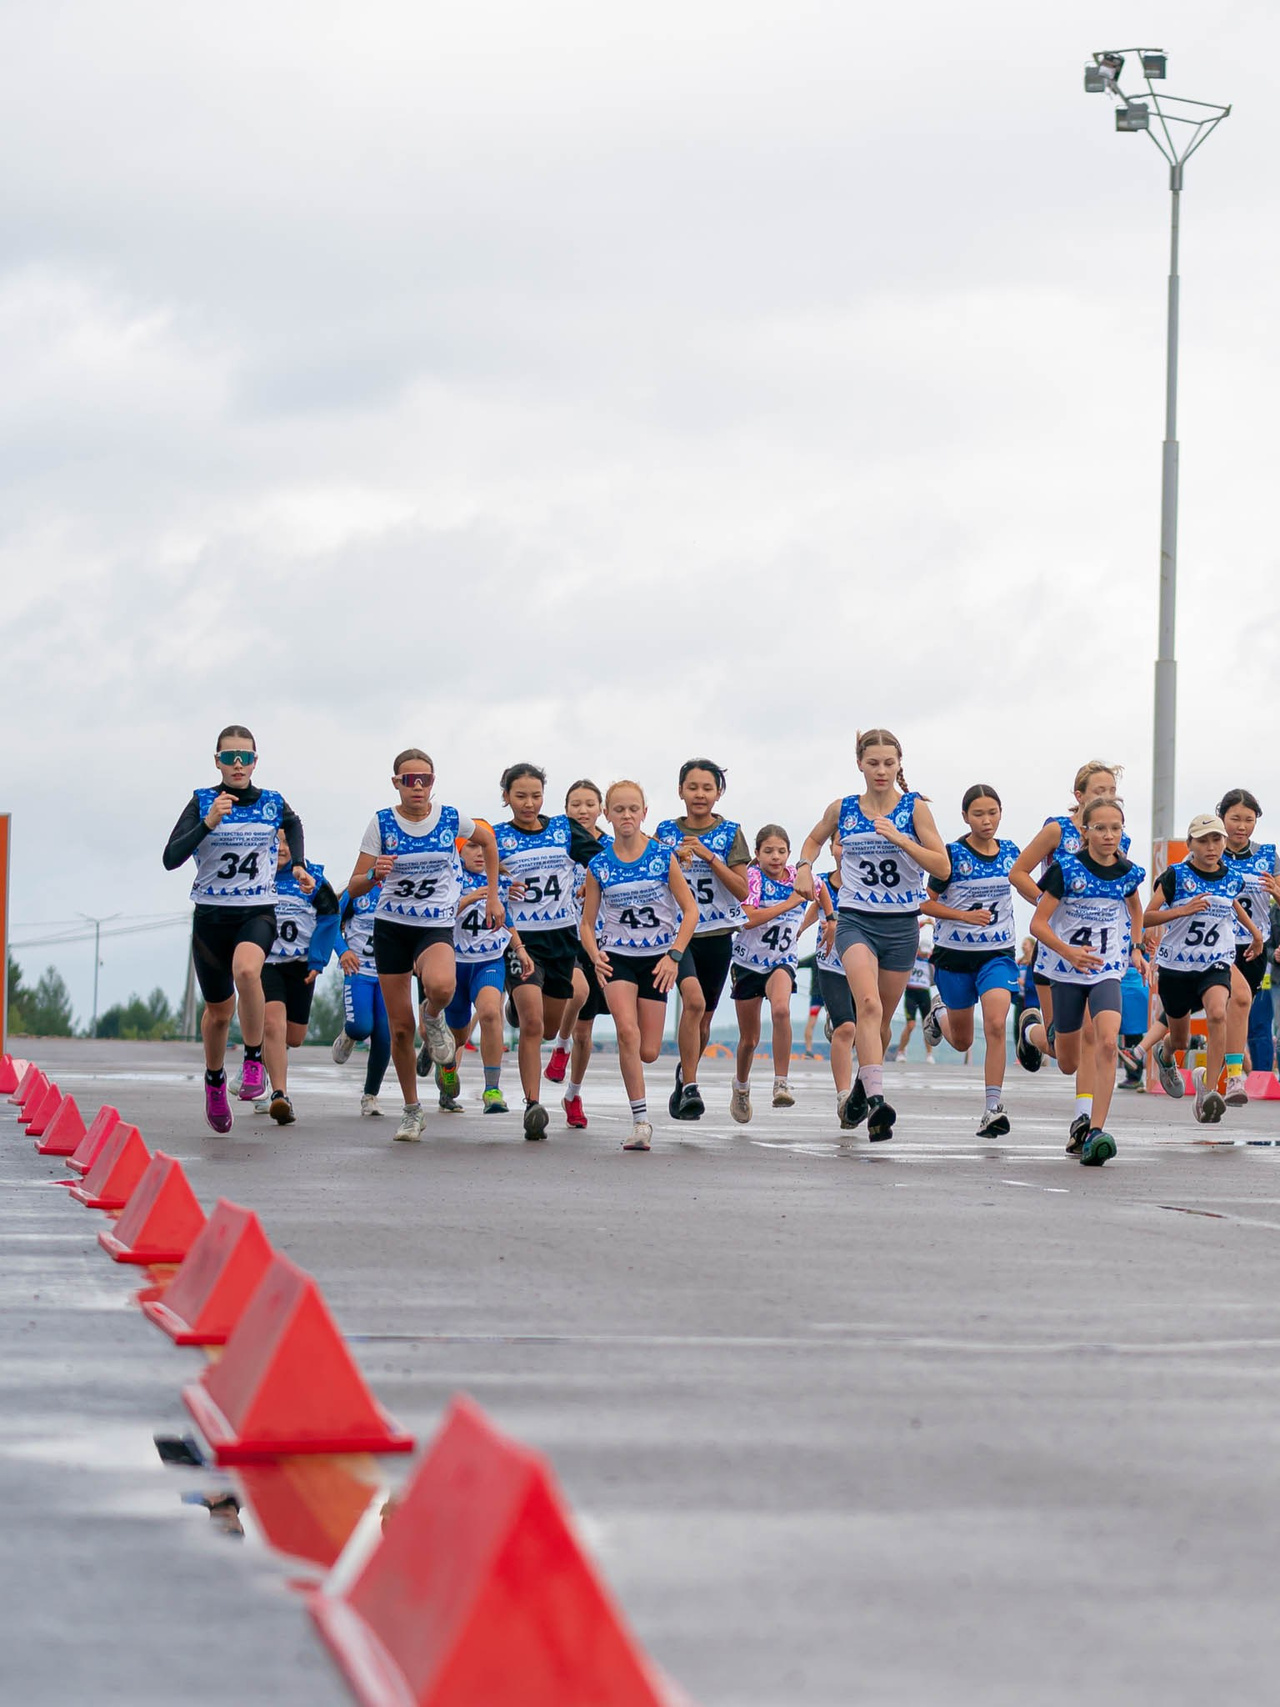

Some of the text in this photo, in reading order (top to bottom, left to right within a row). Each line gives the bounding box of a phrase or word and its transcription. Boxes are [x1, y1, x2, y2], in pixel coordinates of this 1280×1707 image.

[217, 852, 260, 880] 34
[859, 859, 900, 888] 38
[394, 878, 438, 900] 35
[524, 875, 562, 903] 54
[619, 907, 660, 929] 43
[761, 925, 792, 952] 45
[1069, 926, 1109, 954] 41
[1184, 920, 1220, 947] 56
[734, 945, 746, 957] 45
[1159, 947, 1169, 958] 56
